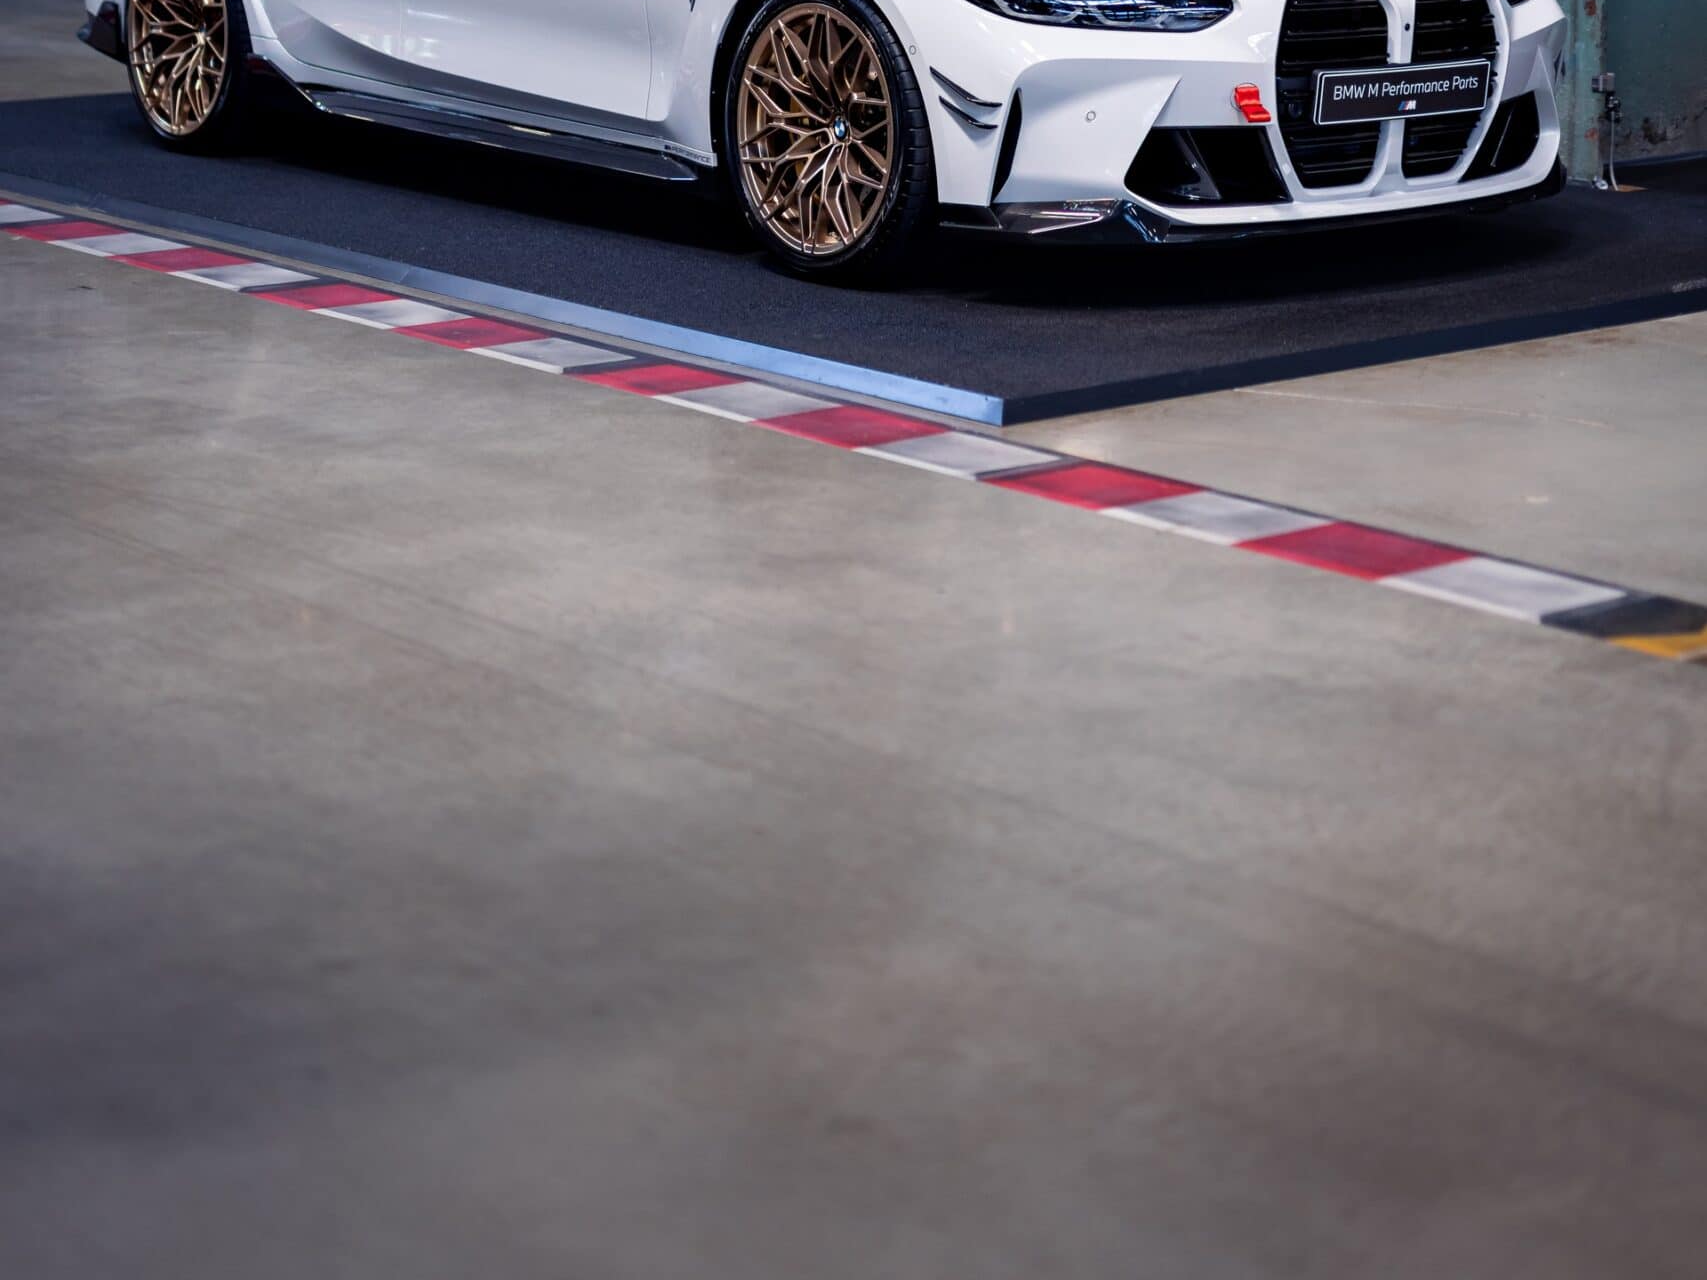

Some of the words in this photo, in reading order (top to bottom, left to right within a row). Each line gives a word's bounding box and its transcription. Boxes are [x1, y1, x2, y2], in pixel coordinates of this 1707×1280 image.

[1333, 83, 1367, 101] BMW
[1367, 82, 1379, 97] M
[1381, 77, 1450, 97] Performance
[1452, 75, 1479, 90] Parts
